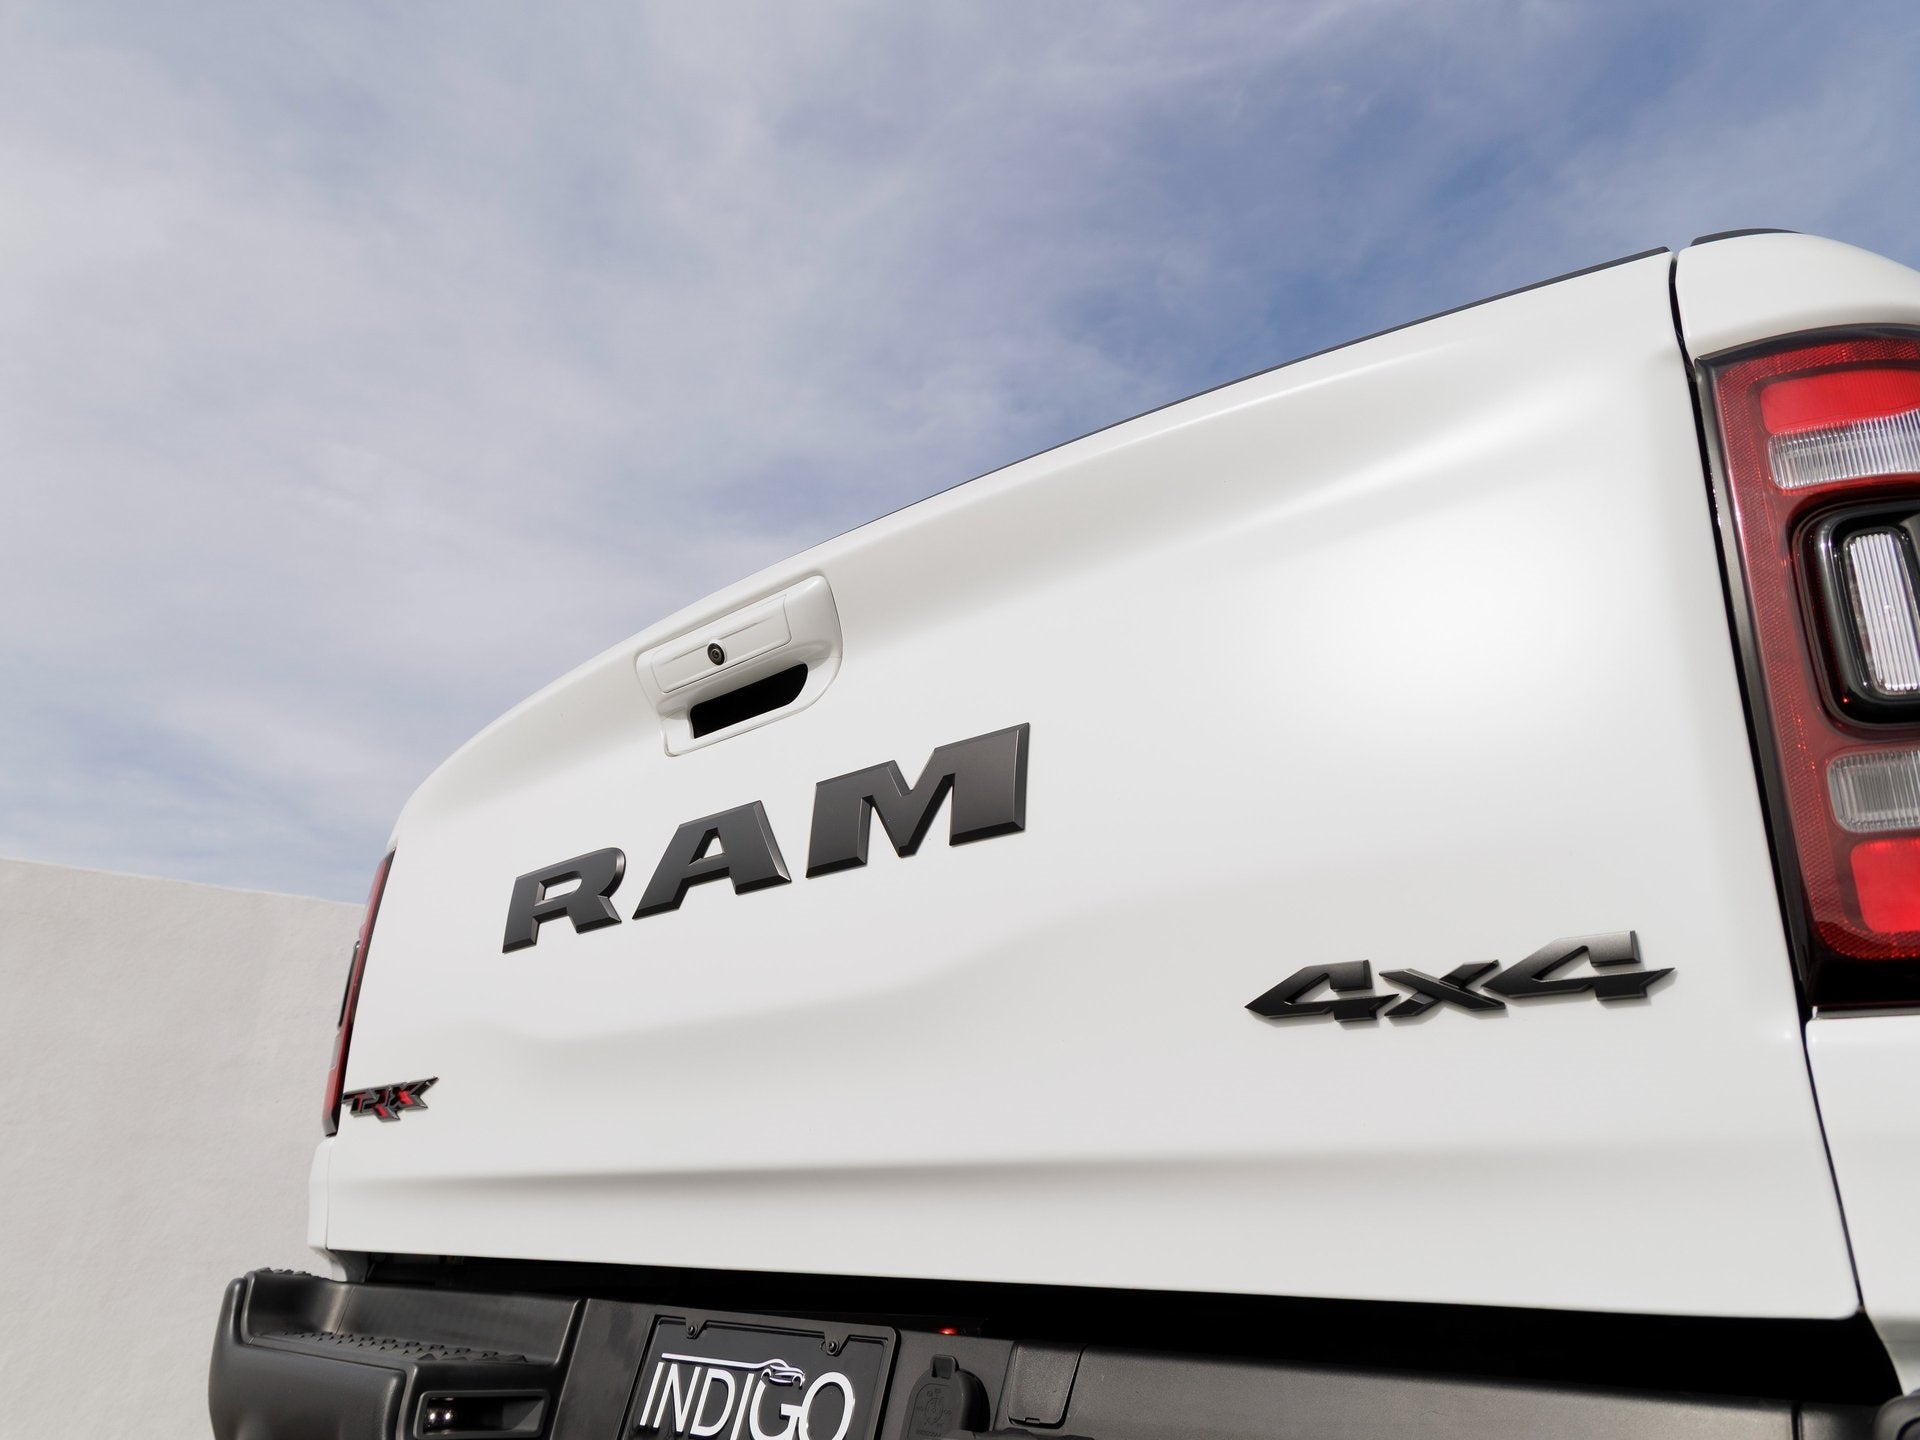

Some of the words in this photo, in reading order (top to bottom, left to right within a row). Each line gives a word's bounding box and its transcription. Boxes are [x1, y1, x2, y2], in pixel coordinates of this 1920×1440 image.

[502, 722, 1030, 953] RAM
[1244, 930, 1676, 1021] 4x4
[341, 1076, 439, 1123] TRX
[639, 1360, 855, 1440] INDIGO
